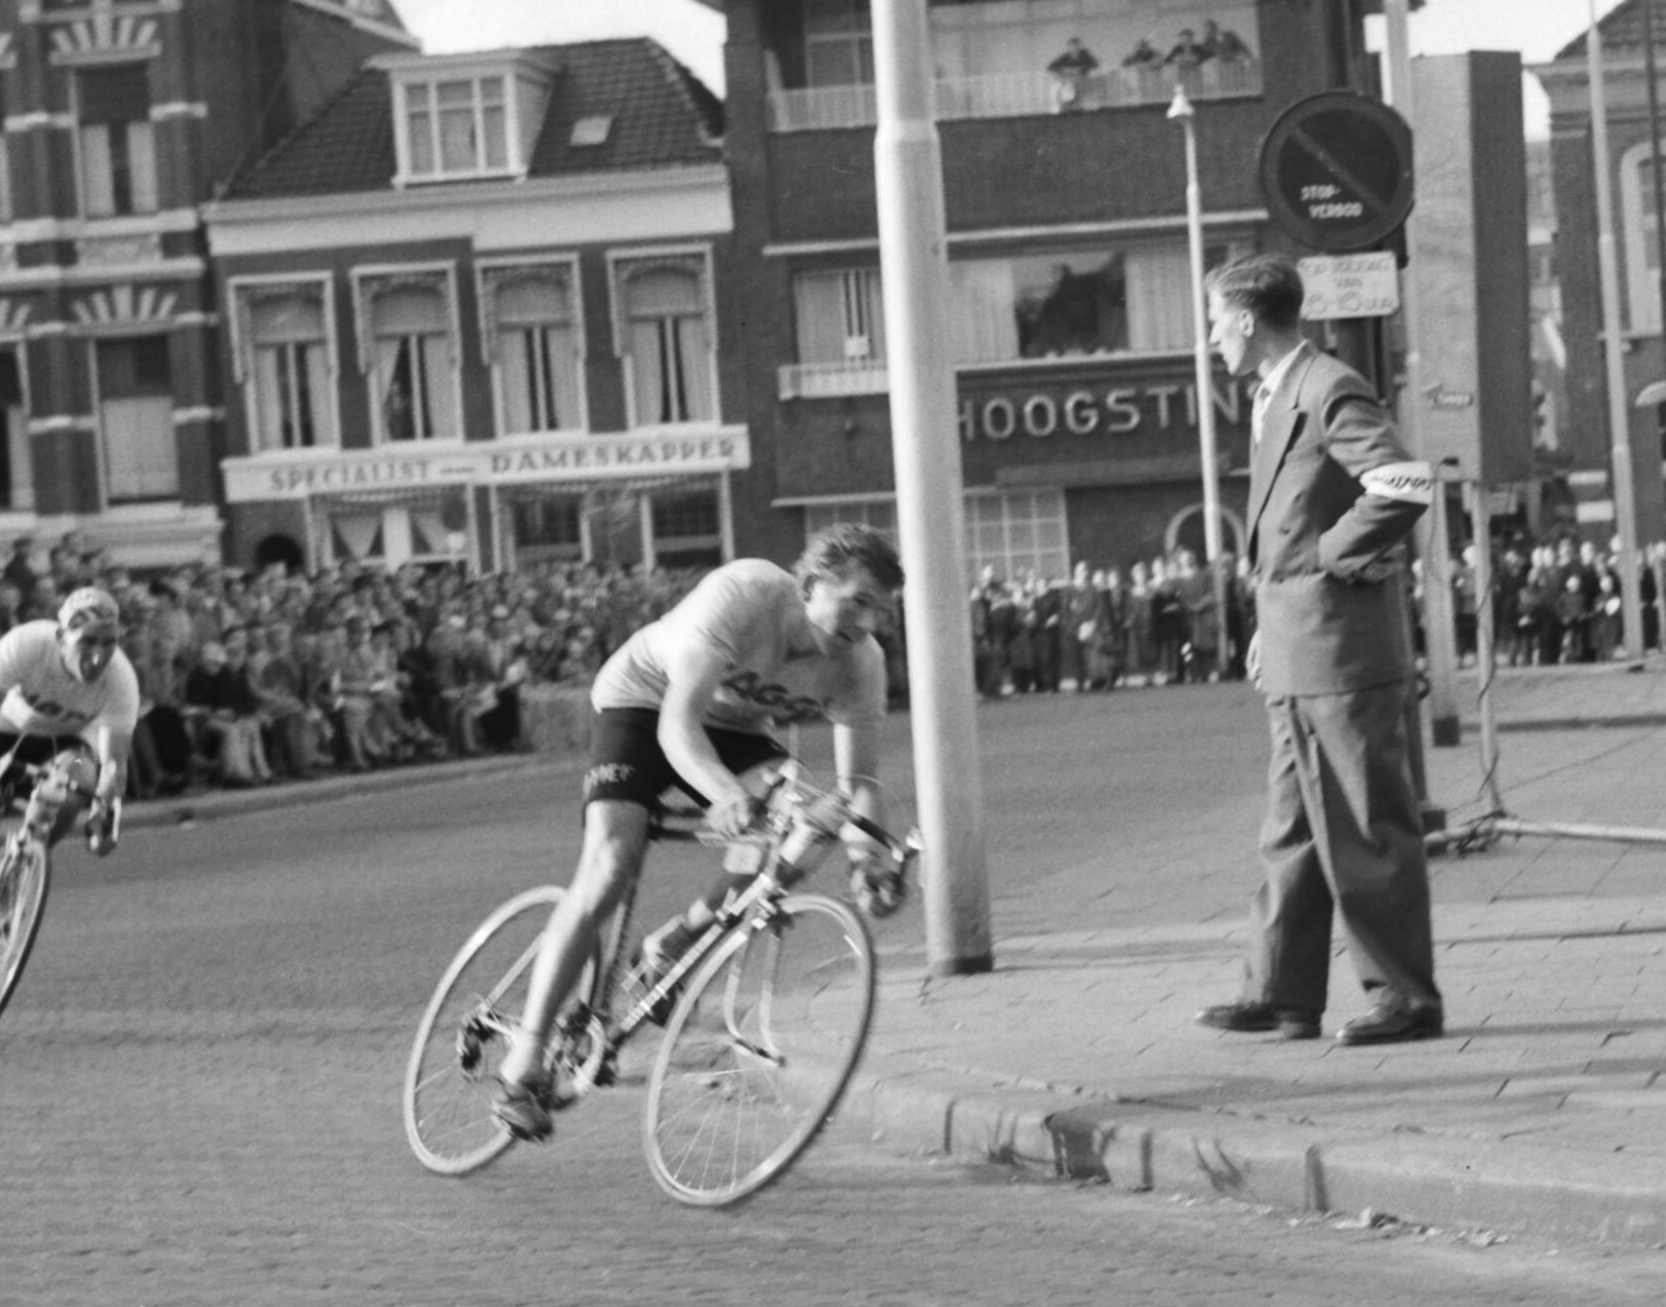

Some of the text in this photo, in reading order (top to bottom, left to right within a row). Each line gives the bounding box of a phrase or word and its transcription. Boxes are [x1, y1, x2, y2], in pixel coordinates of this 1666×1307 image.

[1309, 202, 1363, 218] VERBOD
[270, 438, 735, 490] SPECIALIST DAMESKAPPER
